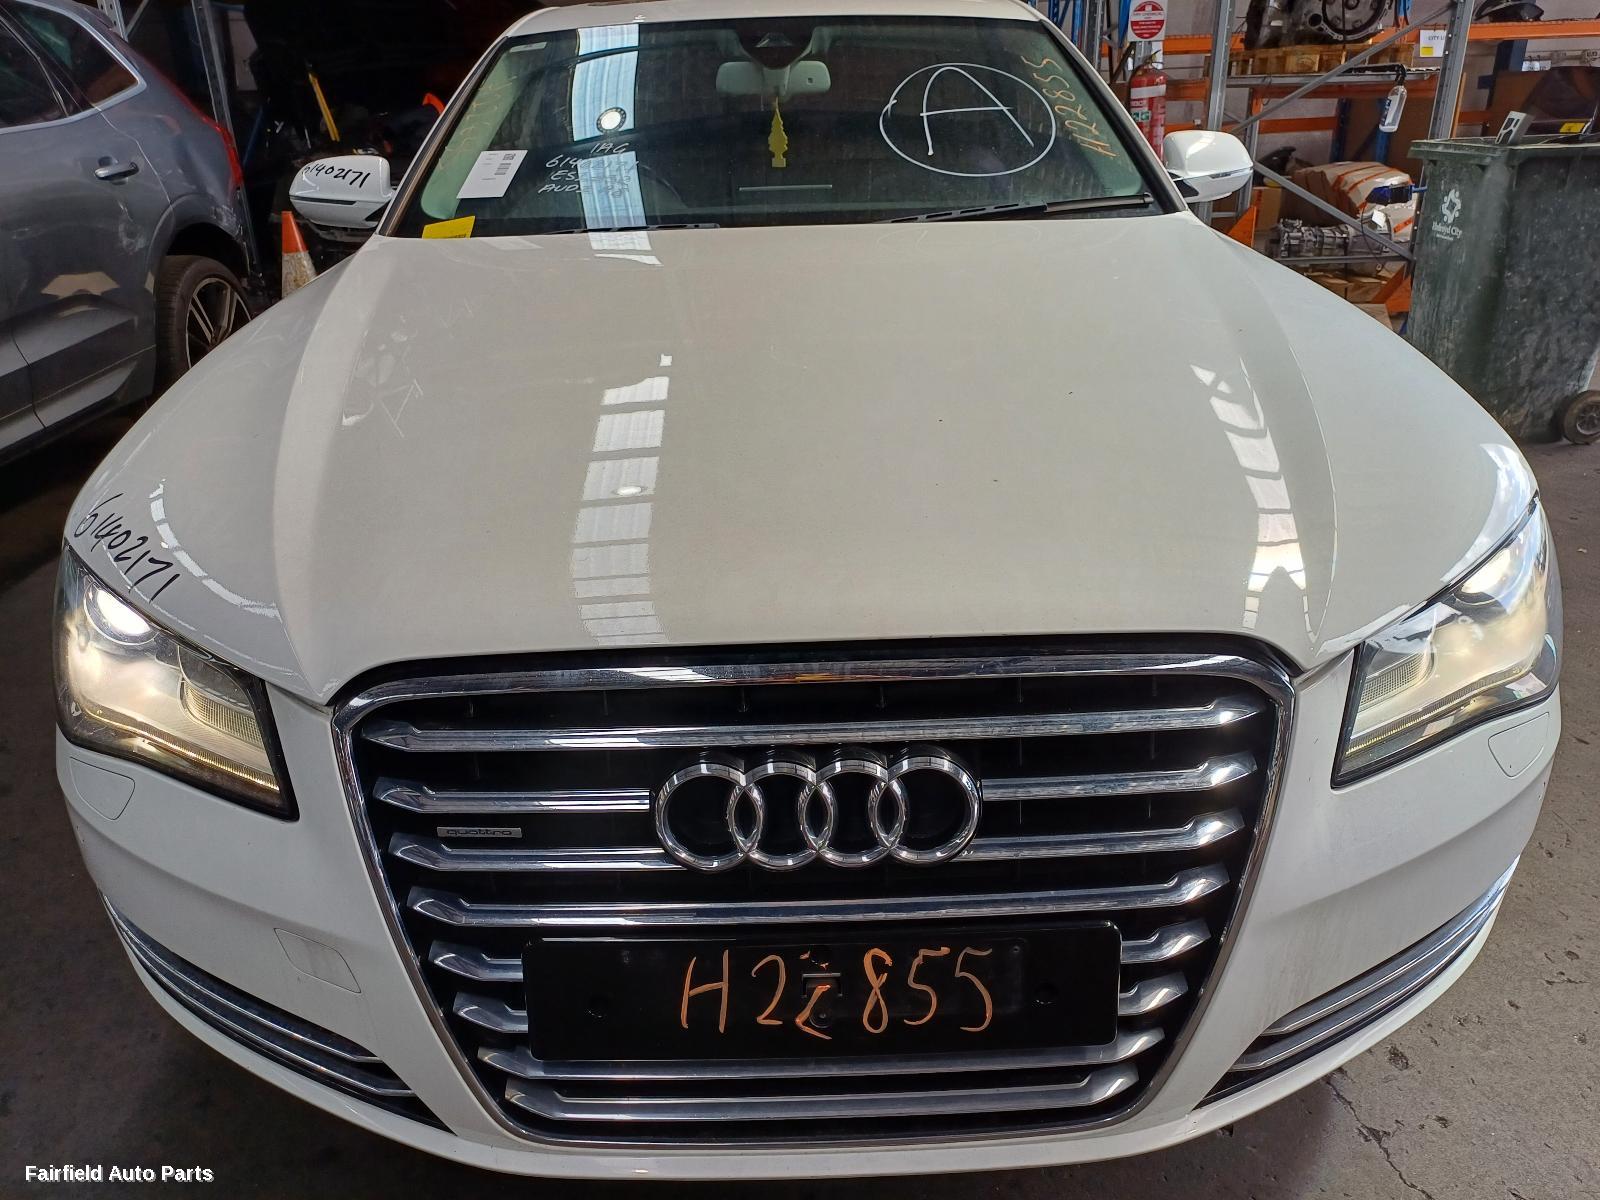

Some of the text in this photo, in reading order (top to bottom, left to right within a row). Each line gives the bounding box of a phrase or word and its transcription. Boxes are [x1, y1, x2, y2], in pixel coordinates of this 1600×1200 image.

[919, 66, 1035, 156] A
[73, 492, 181, 604] 61402171
[446, 828, 513, 836] quattro
